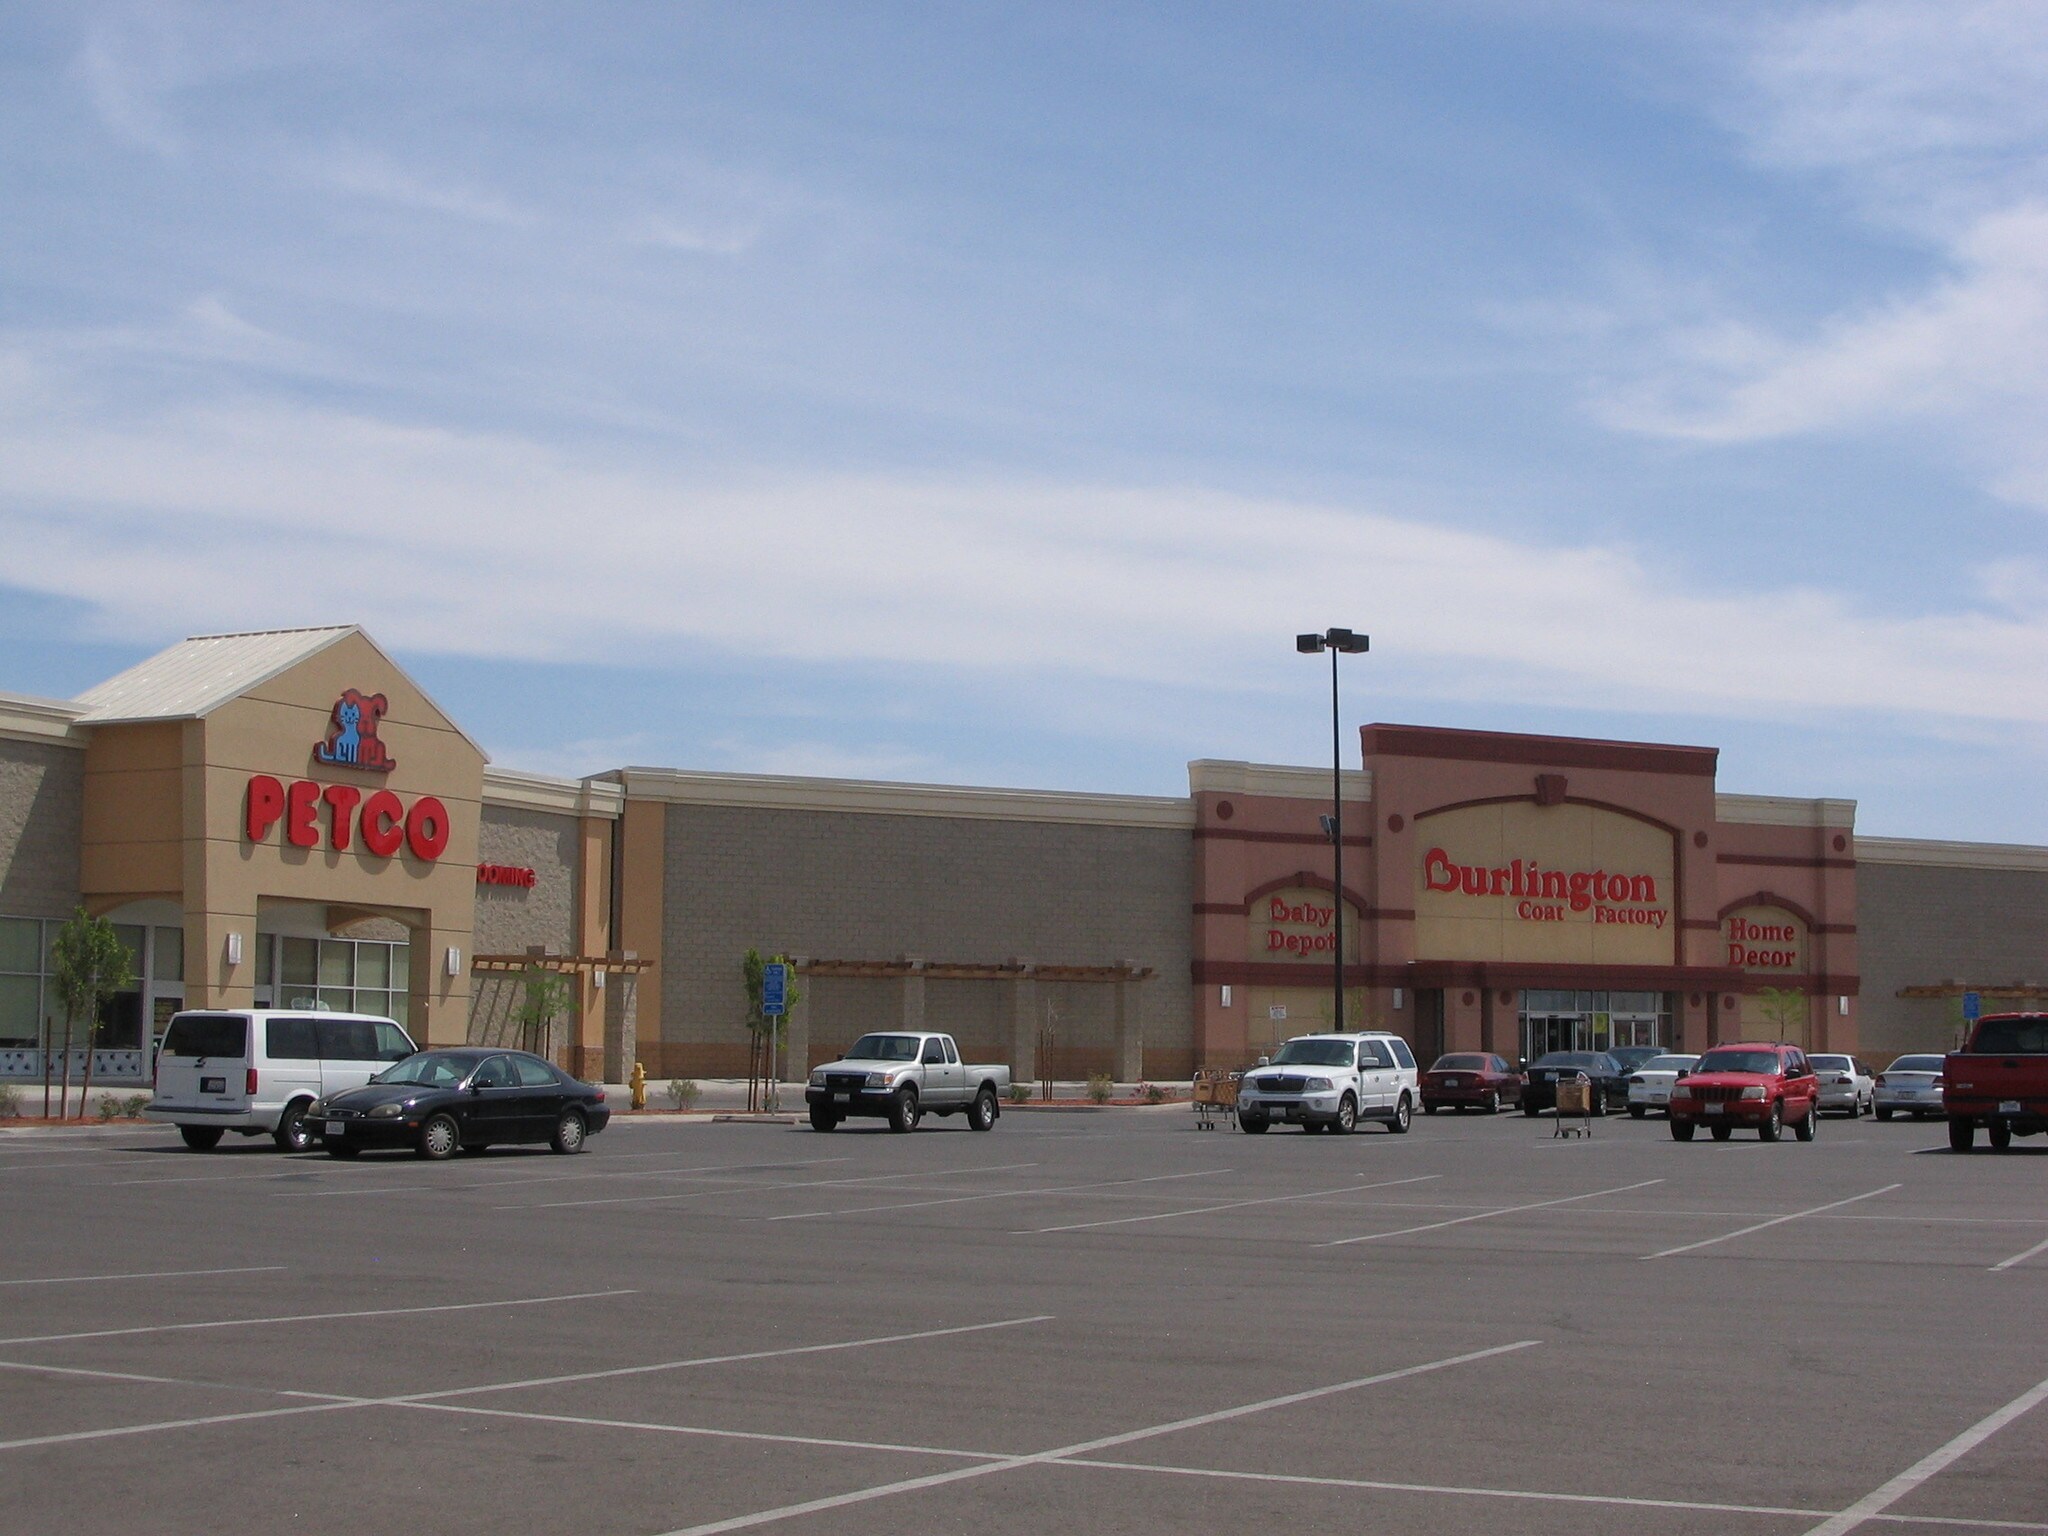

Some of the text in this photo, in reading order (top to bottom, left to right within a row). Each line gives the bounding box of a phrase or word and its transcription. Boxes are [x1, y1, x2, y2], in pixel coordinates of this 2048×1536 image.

[247, 775, 449, 861] PETCO
[1424, 848, 1657, 911] Burlington
[1269, 898, 1335, 928] Baby
[1517, 901, 1668, 929] Coat Factory
[1266, 930, 1336, 956] Depot
[1728, 917, 1795, 941] Home
[1728, 944, 1797, 967] Decor
